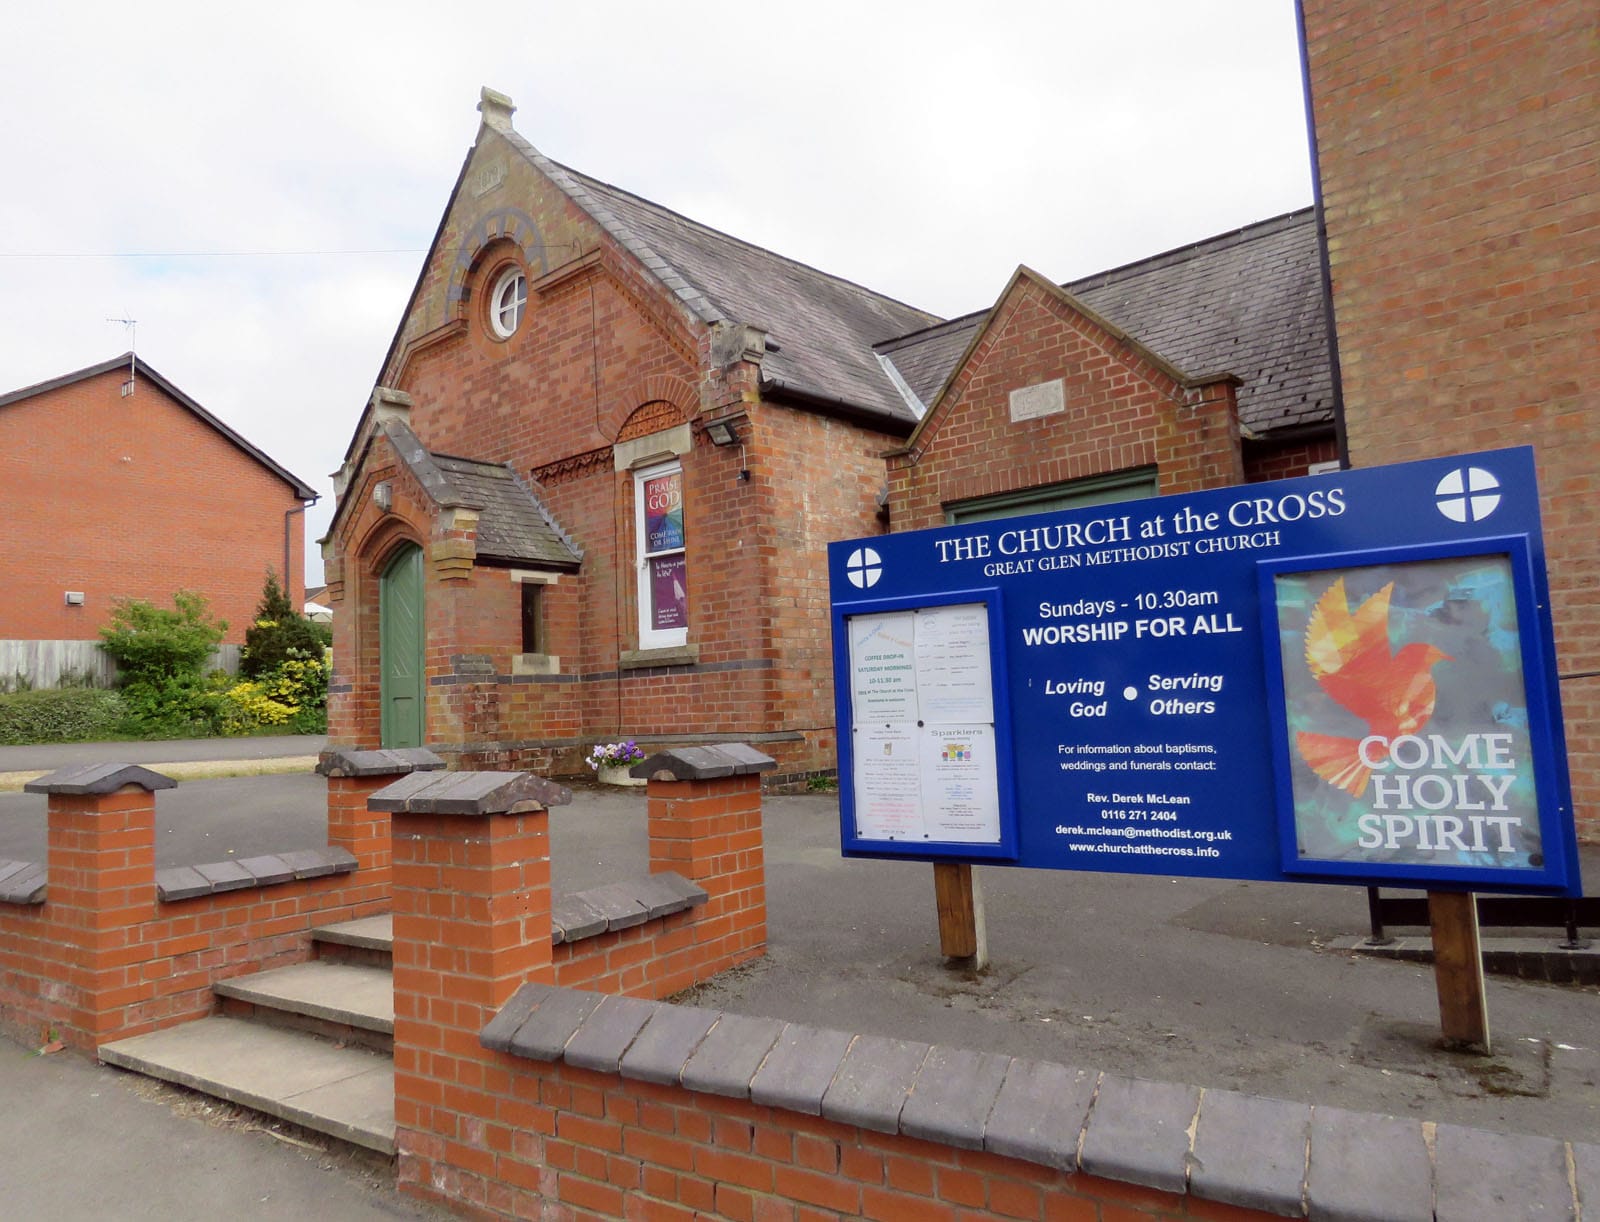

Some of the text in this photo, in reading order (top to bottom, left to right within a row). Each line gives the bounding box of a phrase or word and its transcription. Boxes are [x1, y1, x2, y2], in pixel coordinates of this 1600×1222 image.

[649, 480, 679, 495] PRAISE
[648, 491, 680, 510] GOD
[935, 488, 1347, 563] THE CHURCH at the CROSS
[983, 530, 1281, 577] GREAT GLEN METHODIST CHURCH
[1039, 599, 1116, 619] Sundays
[1134, 589, 1219, 611] 10.30am
[1022, 613, 1243, 646] WORSHIP FOR ALL
[1045, 678, 1105, 697] Loving
[1147, 672, 1224, 693] Serving
[1069, 701, 1108, 718] God
[1149, 698, 1215, 715] Others
[931, 729, 983, 738] Sparklers
[1058, 743, 1217, 756] For information about baptisms,
[1358, 733, 1515, 770] COME
[1060, 760, 1217, 773] weddings and funerals contact:
[1087, 792, 1191, 805] Rev. Derek McLean
[1370, 774, 1516, 811] HOLY
[1101, 809, 1177, 821] 0116 271 2404
[1055, 824, 1233, 842] derek.mclean@methodist.org.uk
[1358, 813, 1521, 852] SPIRIT
[1068, 842, 1220, 858] www.churchatthecross.info
